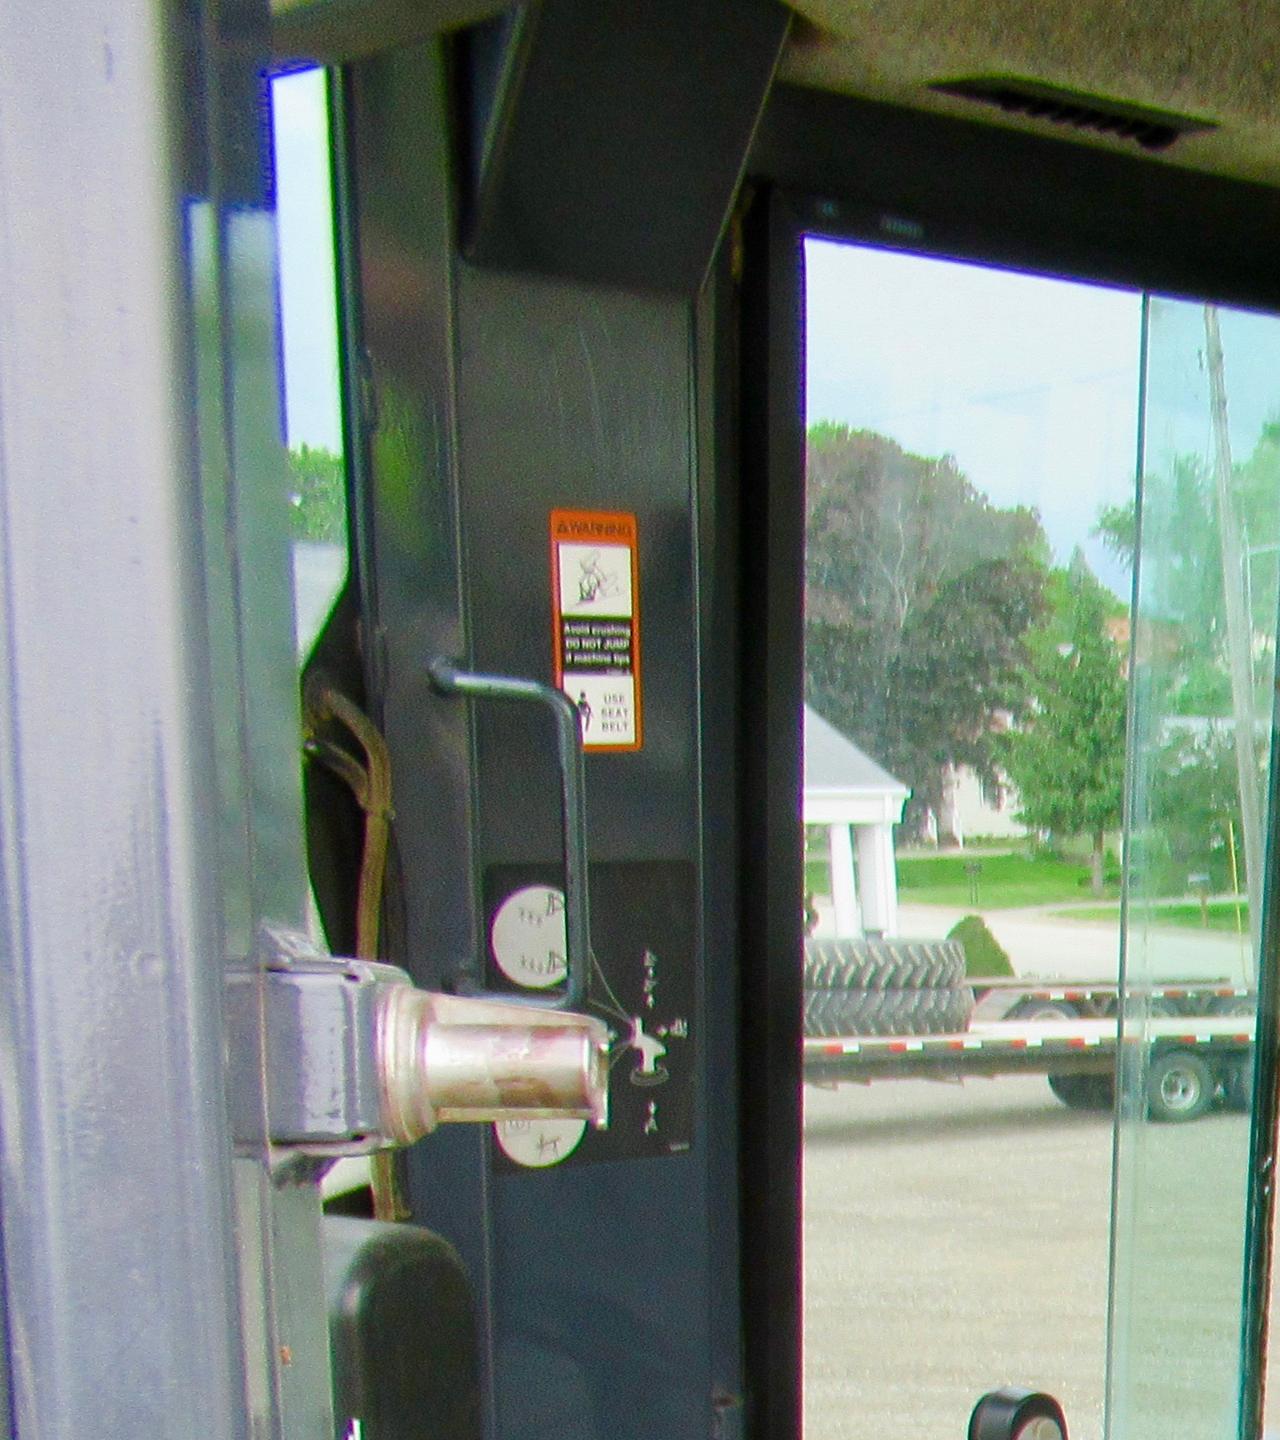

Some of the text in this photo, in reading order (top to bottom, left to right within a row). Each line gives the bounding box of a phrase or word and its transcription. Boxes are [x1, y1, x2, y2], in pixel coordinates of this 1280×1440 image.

[565, 637, 580, 650] DO
[581, 637, 600, 650] NOT
[604, 693, 624, 704] USE
[601, 707, 628, 718] SEAT
[601, 721, 628, 732] BELT
